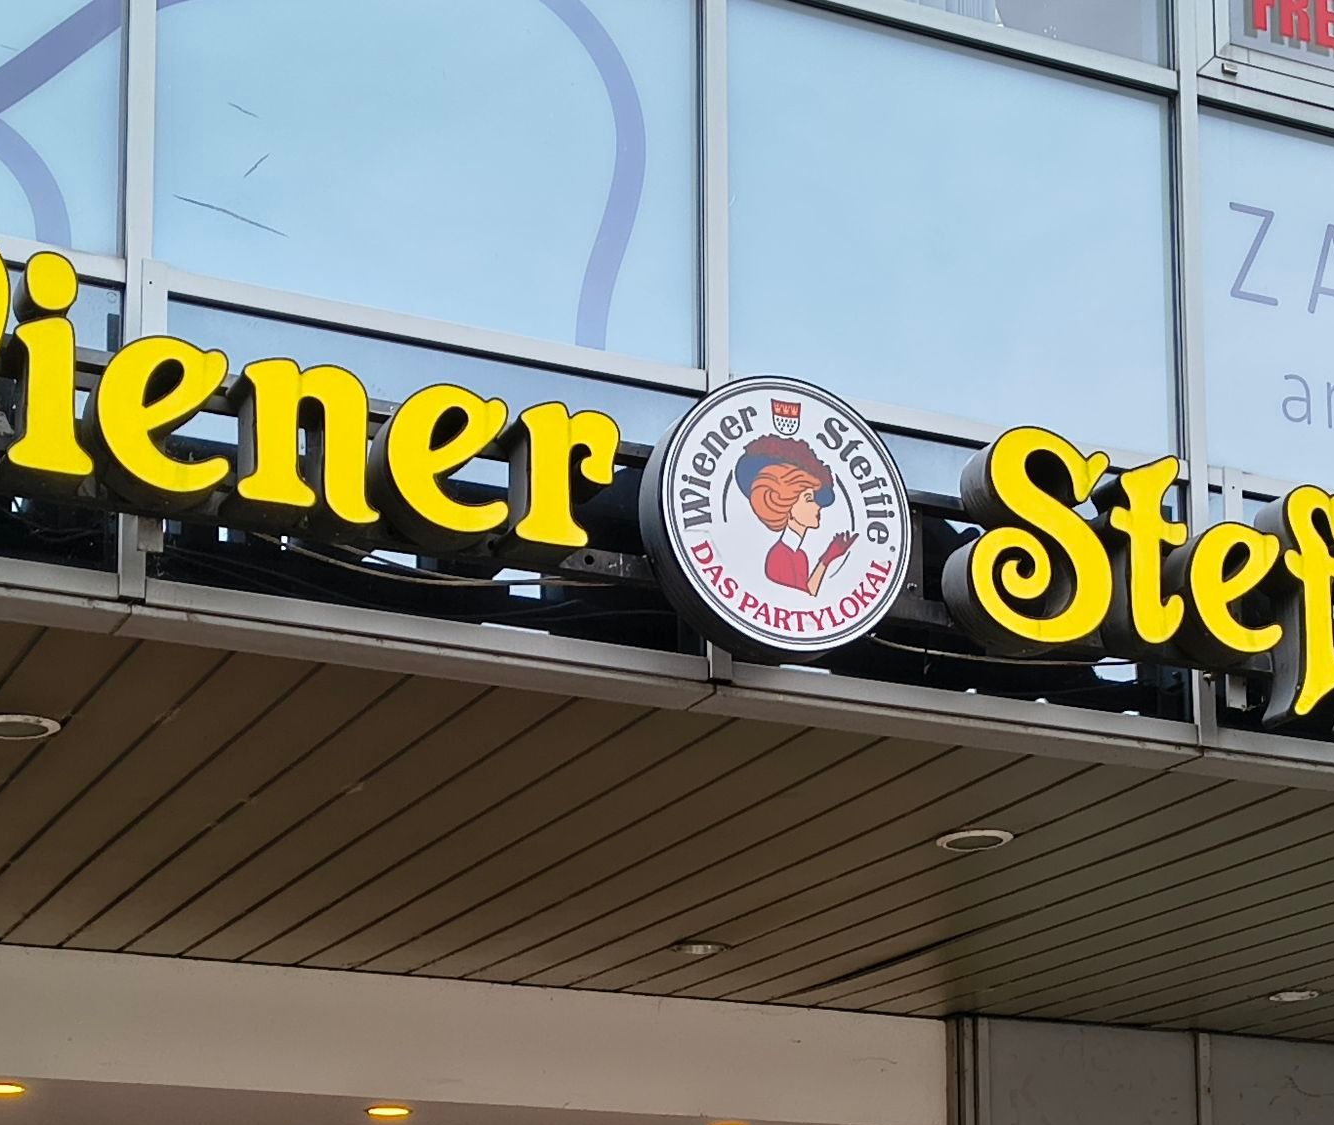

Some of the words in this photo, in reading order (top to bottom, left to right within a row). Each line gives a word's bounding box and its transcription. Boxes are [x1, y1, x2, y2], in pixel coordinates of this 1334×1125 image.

[679, 405, 758, 530] Wiener
[817, 416, 896, 545] Steffie
[691, 540, 739, 600] DAS
[738, 560, 893, 632] PARTYLOKAL
